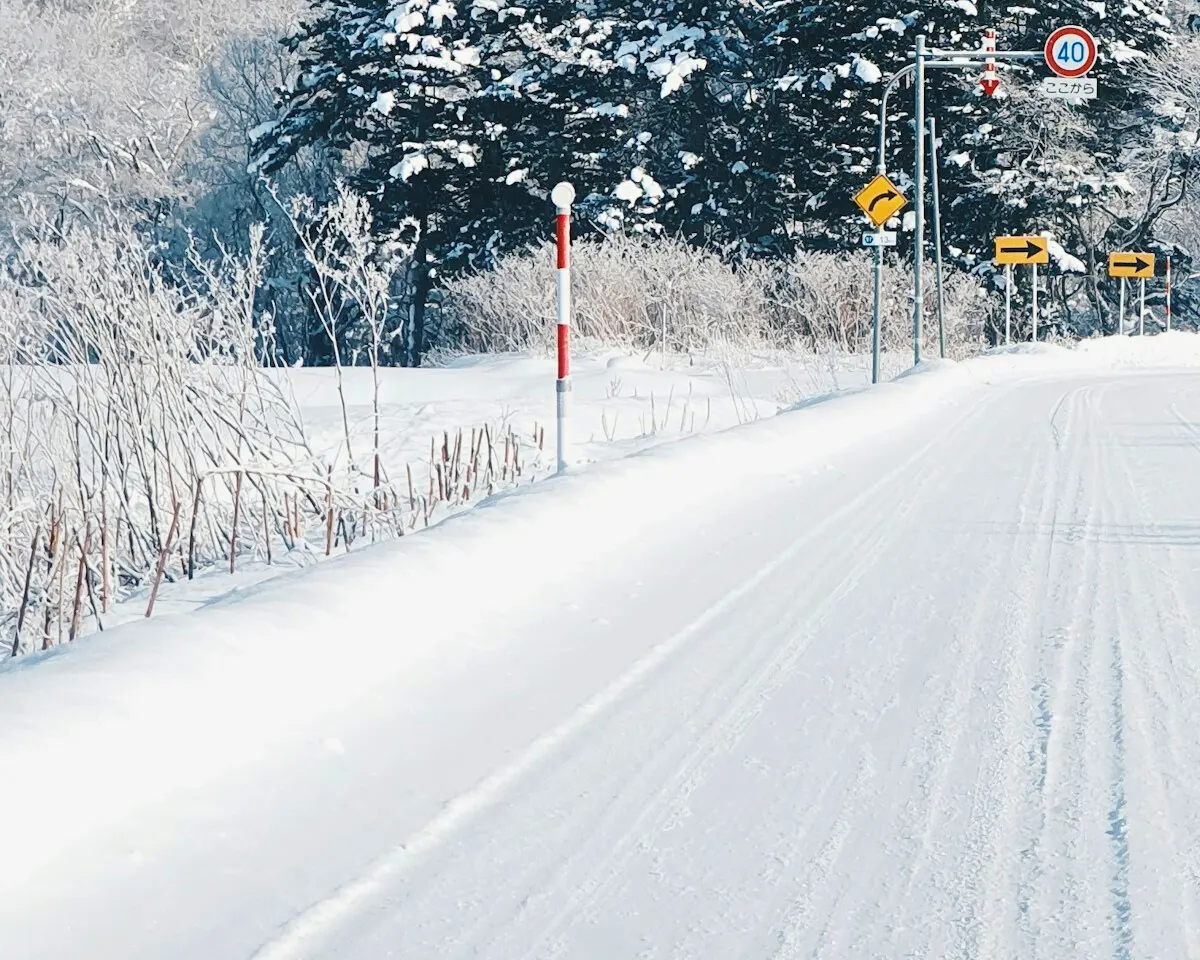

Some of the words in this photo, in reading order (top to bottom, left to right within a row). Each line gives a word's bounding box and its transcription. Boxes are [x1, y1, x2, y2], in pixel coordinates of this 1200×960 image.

[1057, 41, 1084, 62] 40
[1046, 82, 1094, 94] ここから
